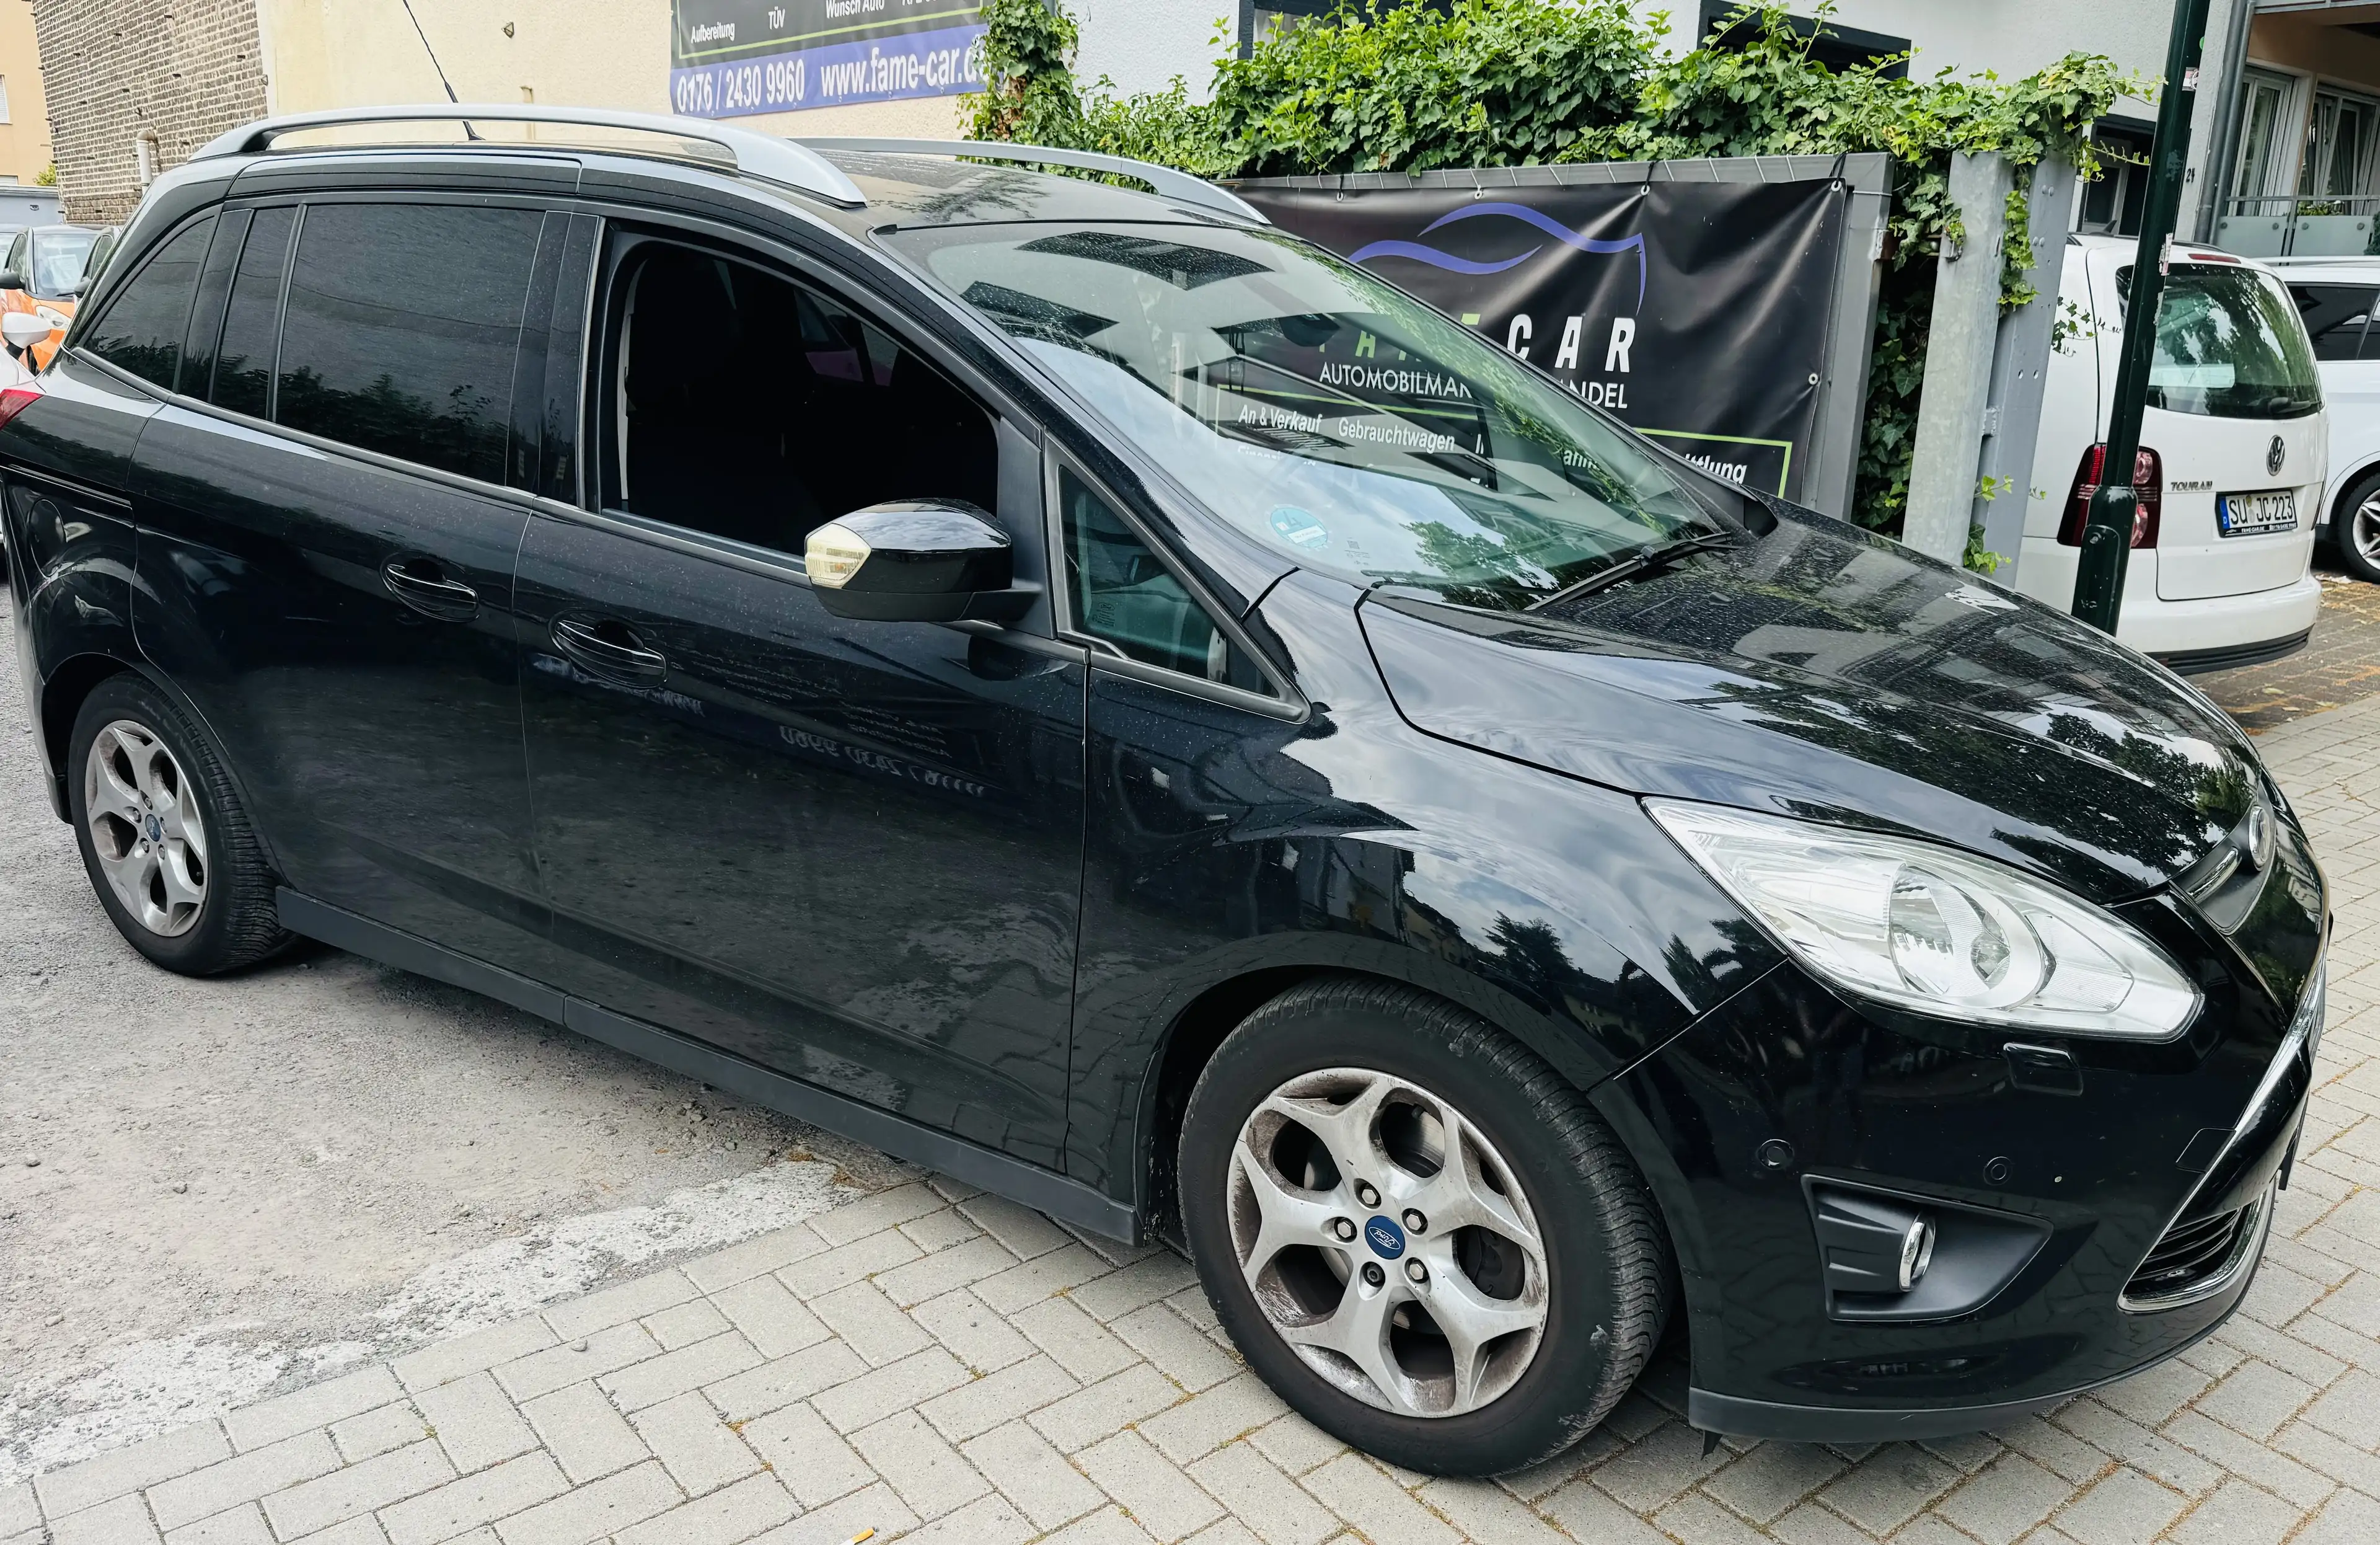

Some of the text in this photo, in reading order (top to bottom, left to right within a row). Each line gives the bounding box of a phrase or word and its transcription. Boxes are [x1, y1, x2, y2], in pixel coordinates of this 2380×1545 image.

[768, 6, 785, 30] TÜV
[826, 0, 860, 19] Wunsch
[690, 22, 735, 43] Aufbereitung
[677, 72, 712, 113] 0176
[726, 65, 761, 108] 2430
[766, 58, 804, 104] 9960
[1238, 404, 1255, 424] An
[1259, 407, 1267, 426] &
[1271, 408, 1323, 433] Verkauf
[1338, 417, 1456, 454] Gebrauchtwagen
[2171, 480, 2213, 492] TOURAN
[2229, 498, 2248, 525] SU
[2256, 497, 2271, 522] JC
[2272, 495, 2293, 521] 223
[1375, 1229, 1396, 1247] Ford
